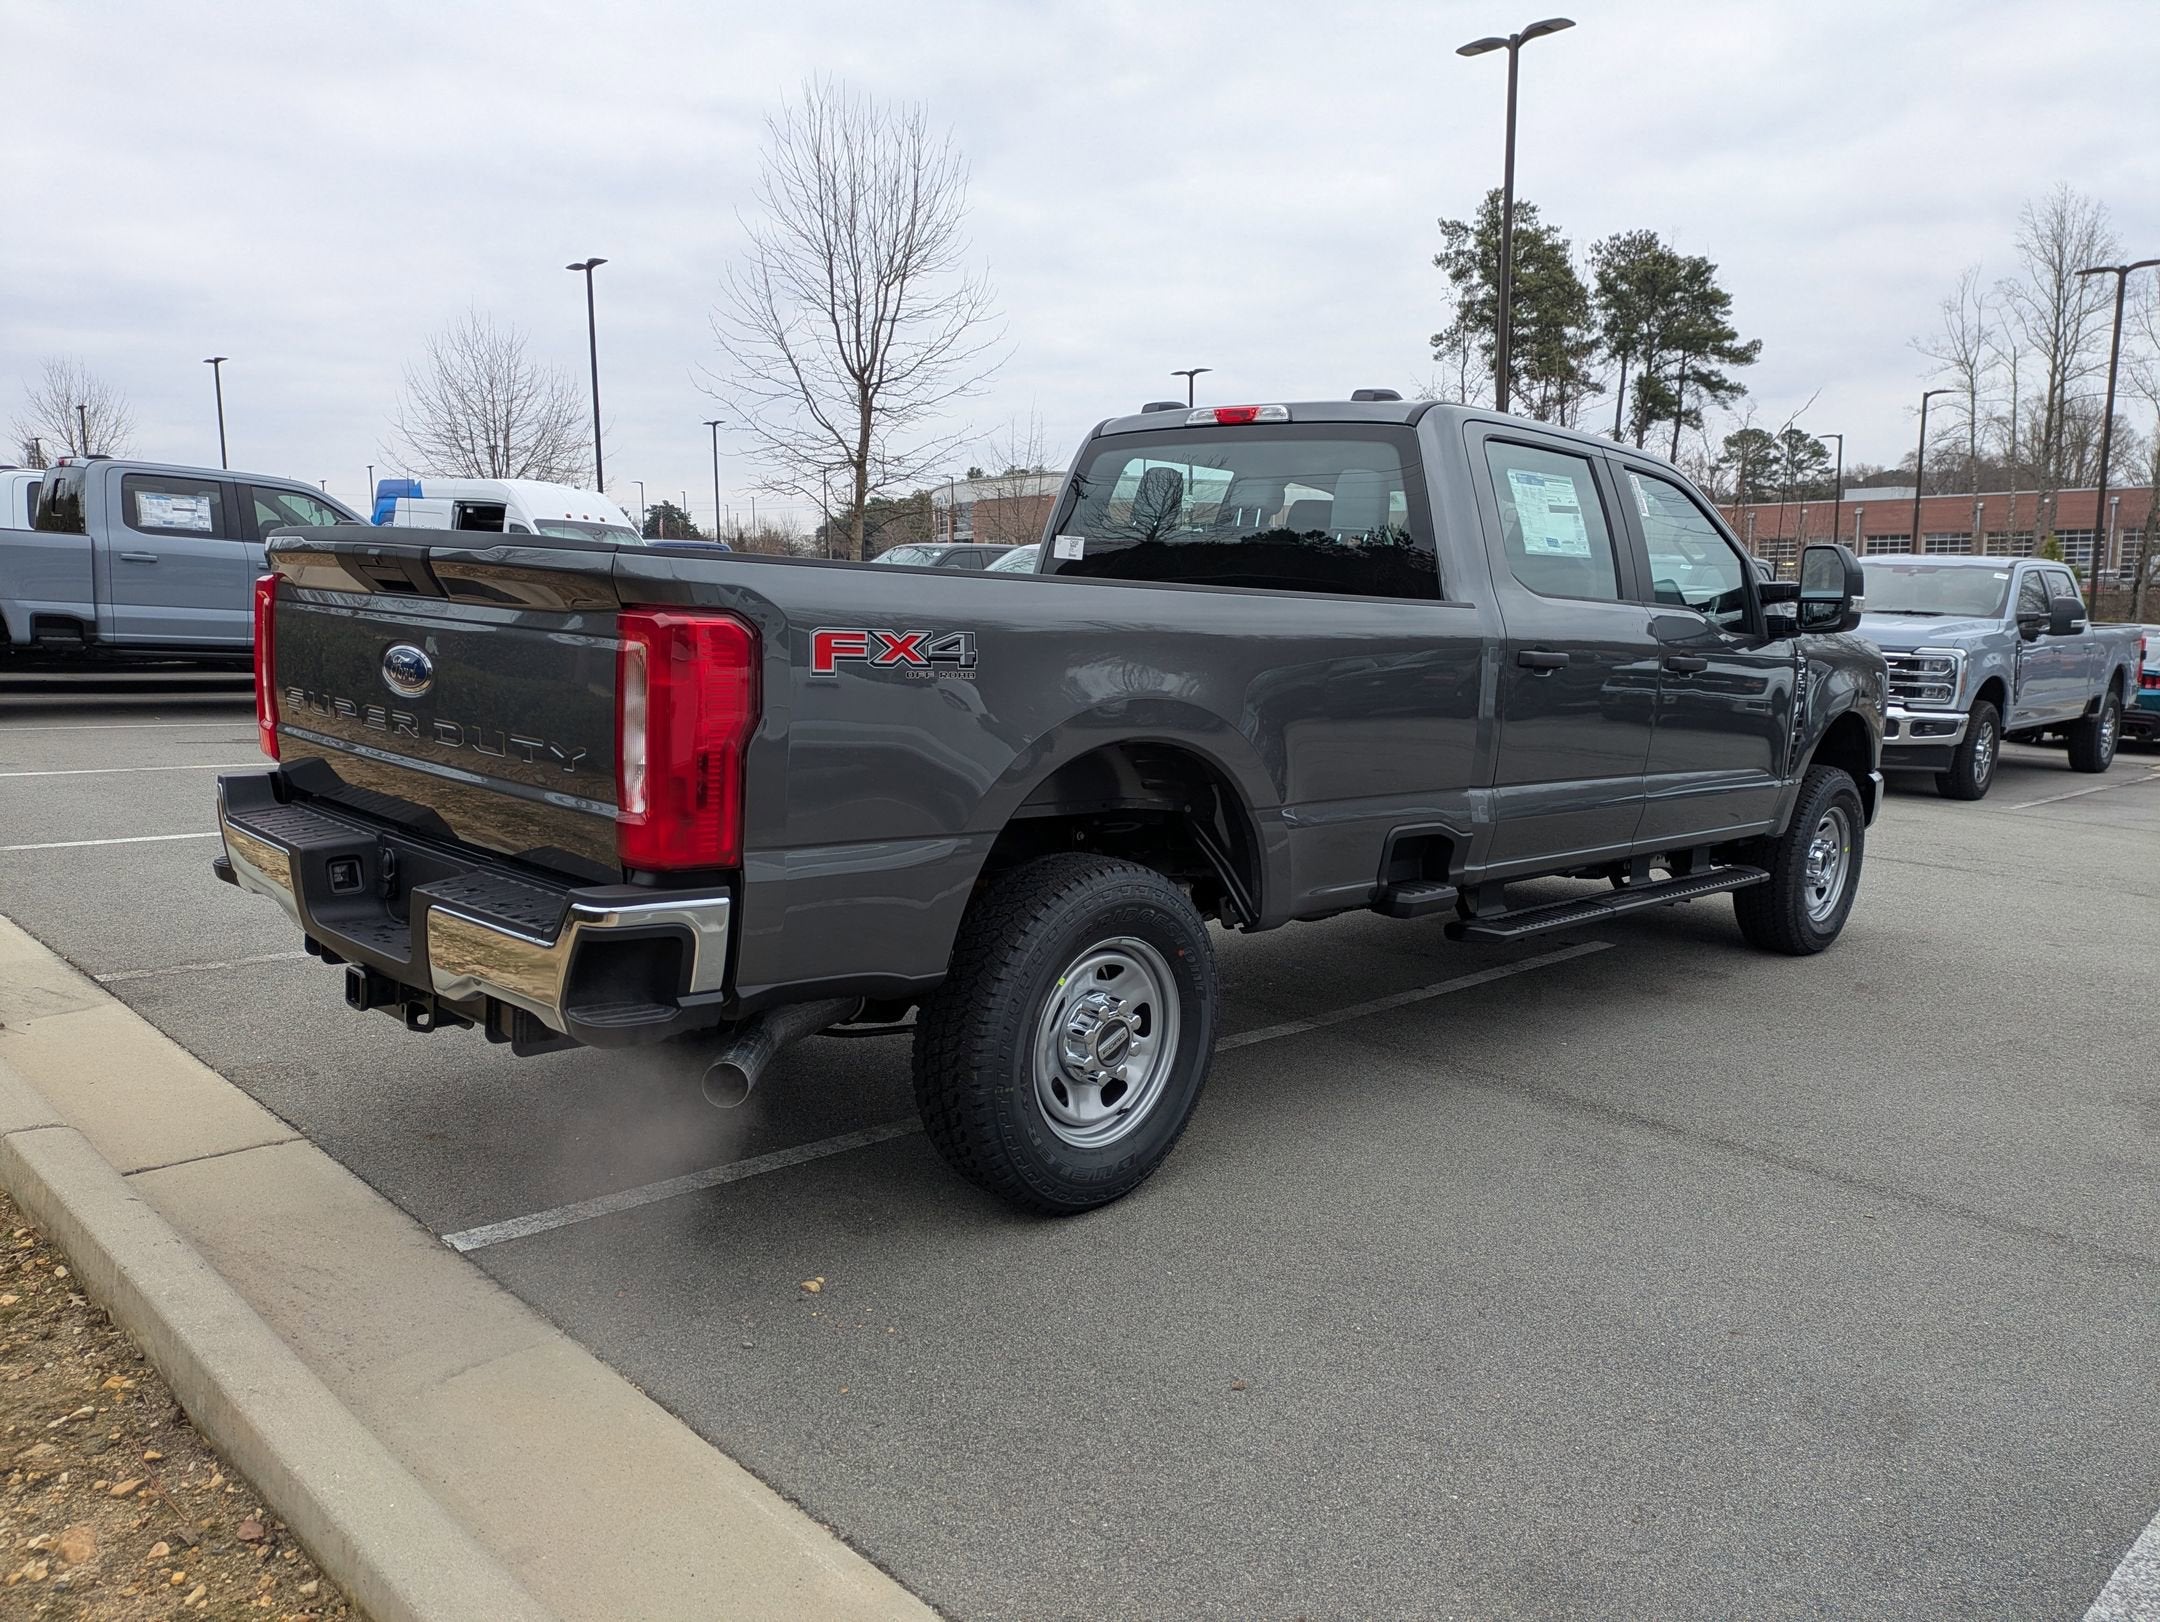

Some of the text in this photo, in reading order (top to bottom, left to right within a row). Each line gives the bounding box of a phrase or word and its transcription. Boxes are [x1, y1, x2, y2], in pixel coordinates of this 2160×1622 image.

[810, 627, 978, 678] FX4
[390, 654, 418, 681] Ford
[906, 671, 976, 680] OFF ROAD
[286, 686, 588, 773] SUPER DUTY
[1102, 1033, 1126, 1055] FORD
